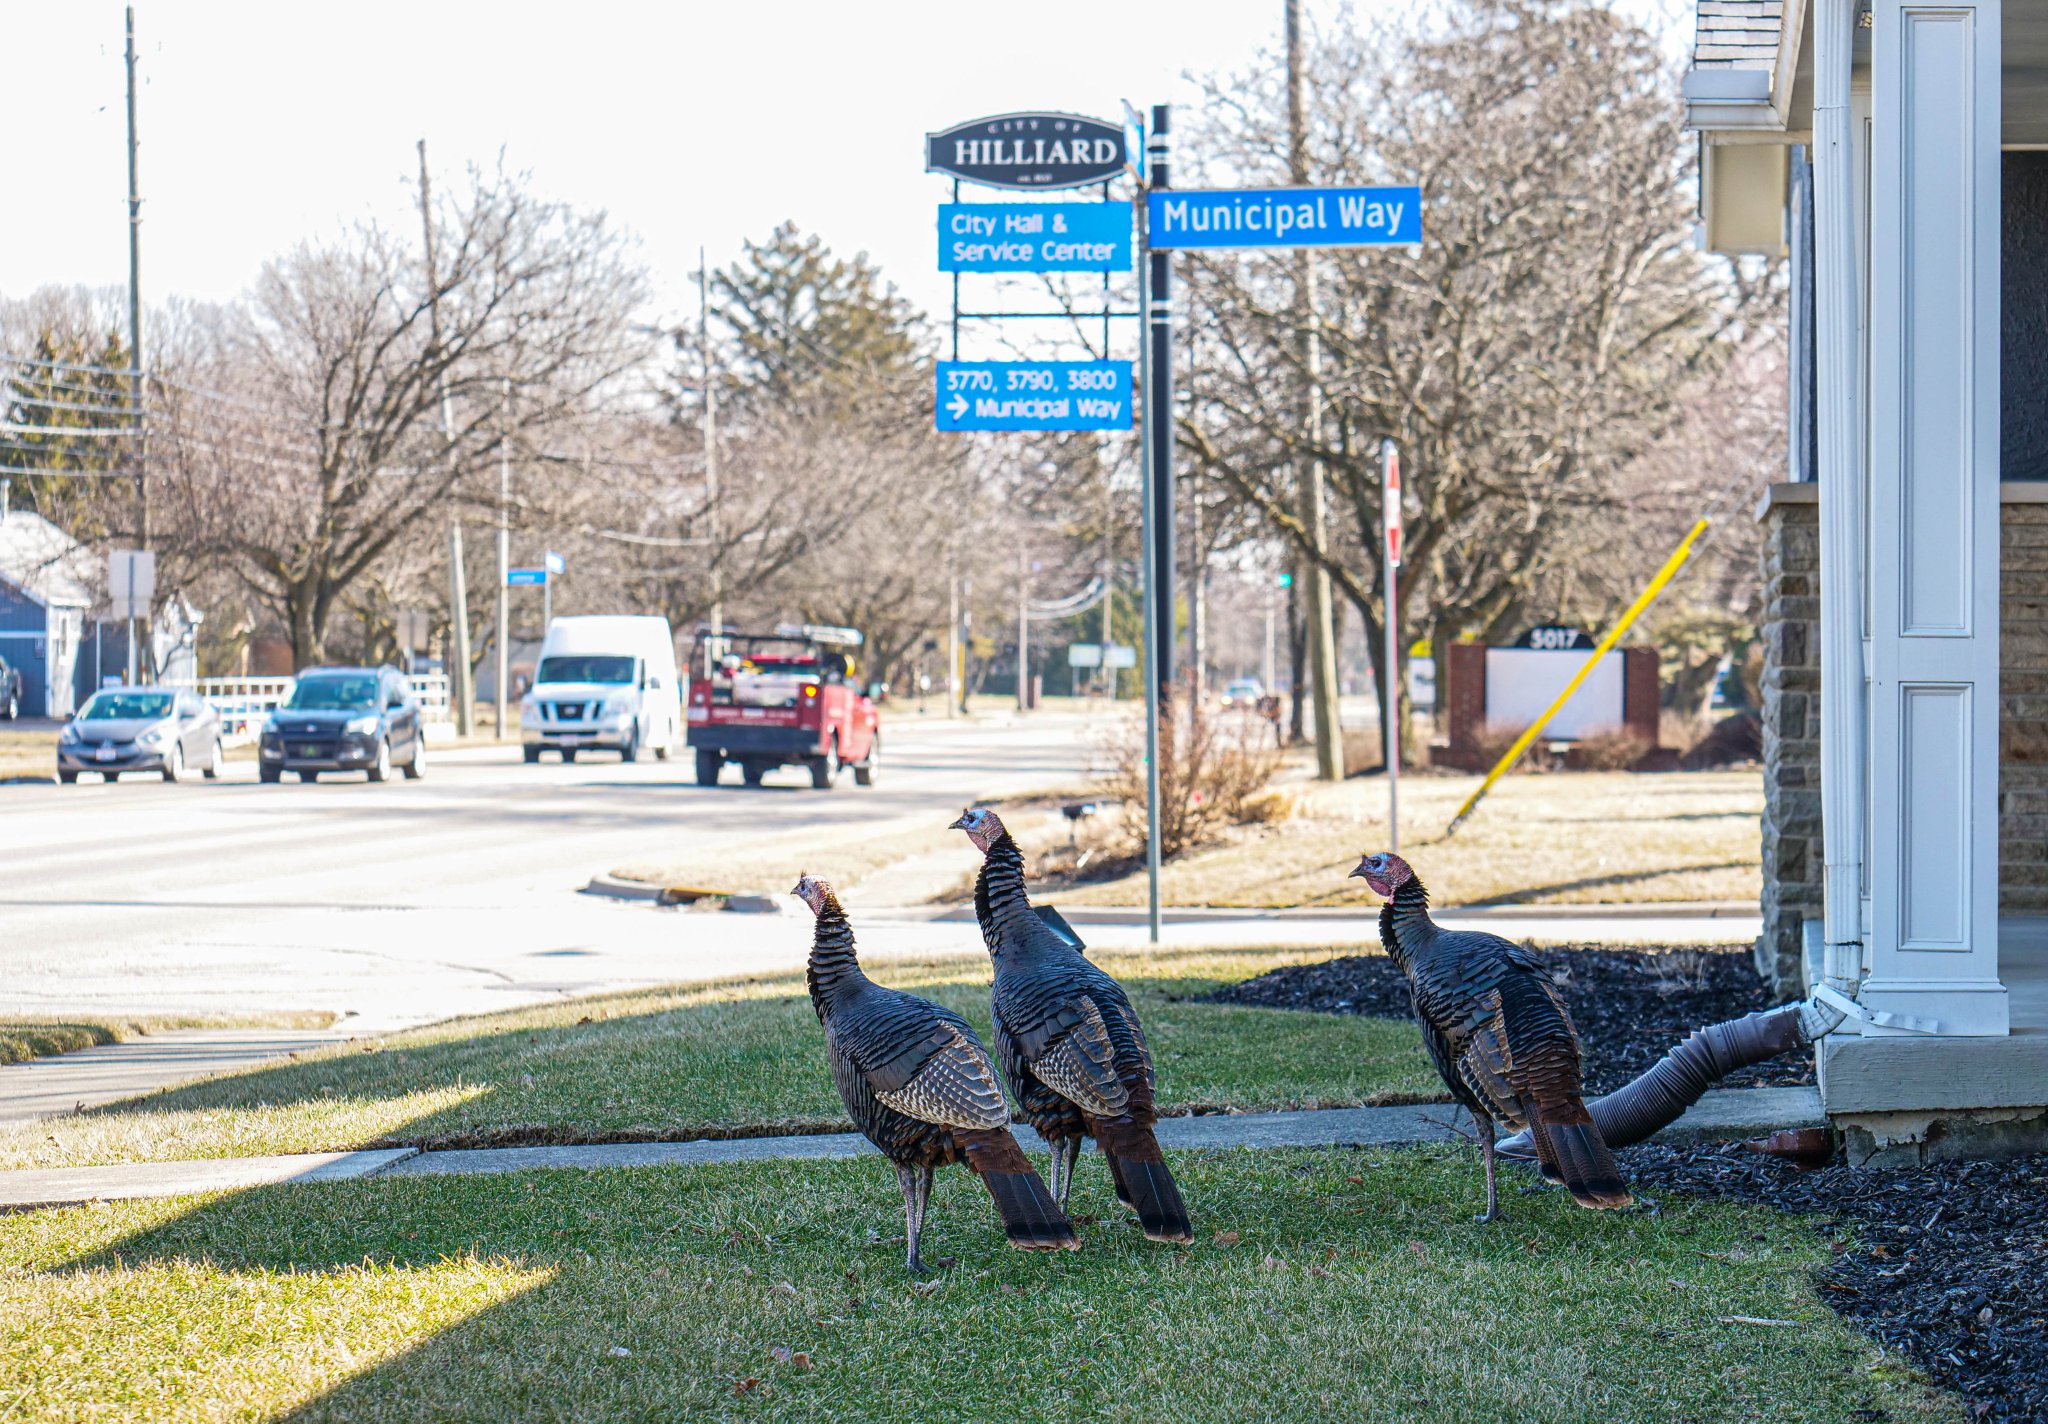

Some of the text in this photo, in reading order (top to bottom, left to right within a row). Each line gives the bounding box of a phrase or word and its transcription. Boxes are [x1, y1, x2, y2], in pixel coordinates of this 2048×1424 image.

[955, 139, 1118, 165] HILLIARD
[951, 213, 1068, 237] City Hall &
[1163, 196, 1404, 238] Municipal Way
[953, 241, 1117, 262] Service Center
[946, 370, 1117, 393] 3770, 3790, 3800
[975, 397, 1121, 421] Municipal Way
[1529, 628, 1579, 649] 5017
